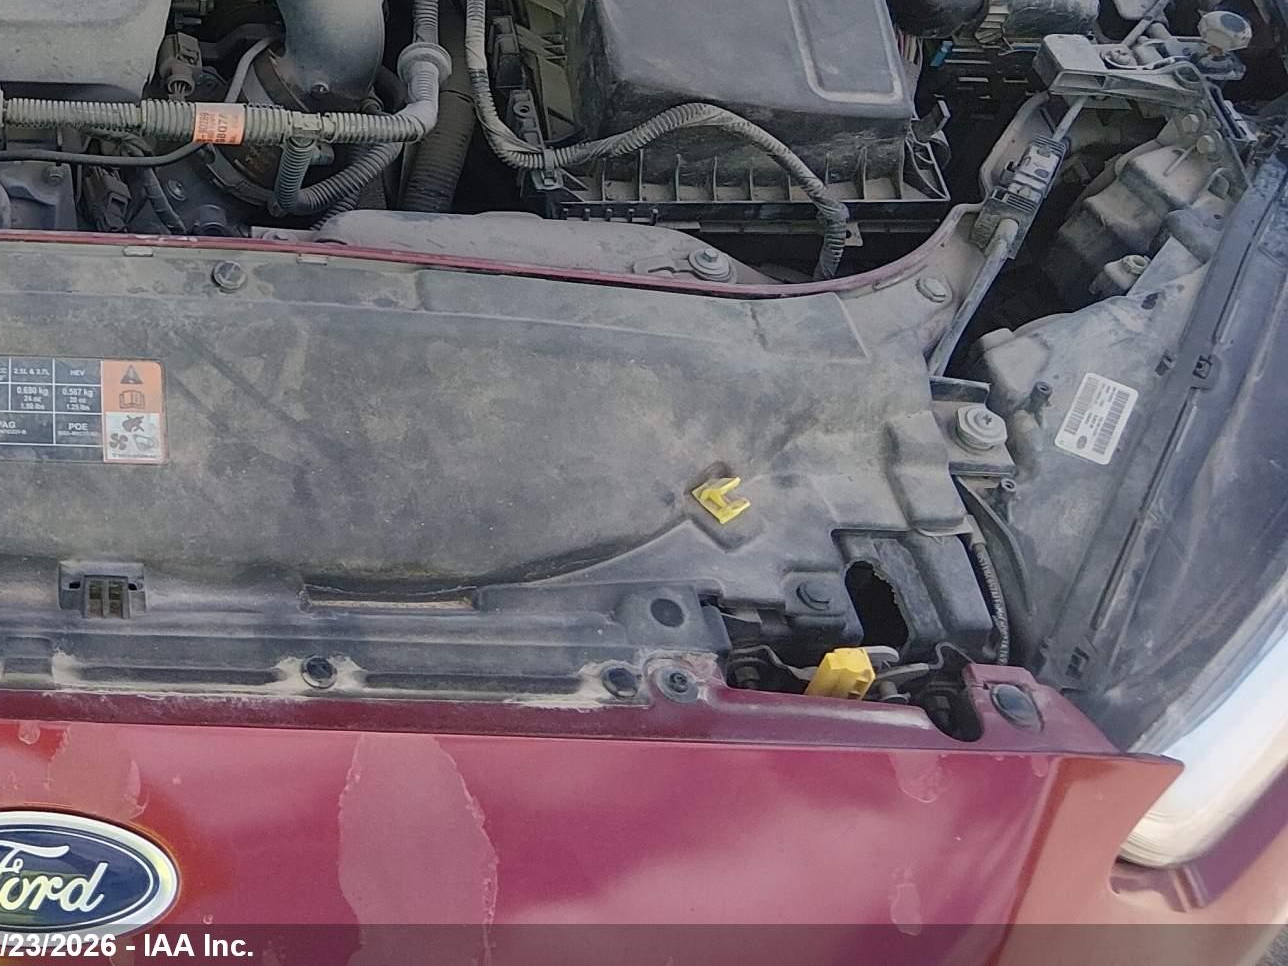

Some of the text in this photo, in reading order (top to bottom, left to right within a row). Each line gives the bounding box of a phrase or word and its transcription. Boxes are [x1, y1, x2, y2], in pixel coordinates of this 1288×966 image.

[69, 369, 86, 377] HEV
[38, 386, 49, 397] kg
[83, 388, 94, 398] kg
[68, 422, 89, 431] POE
